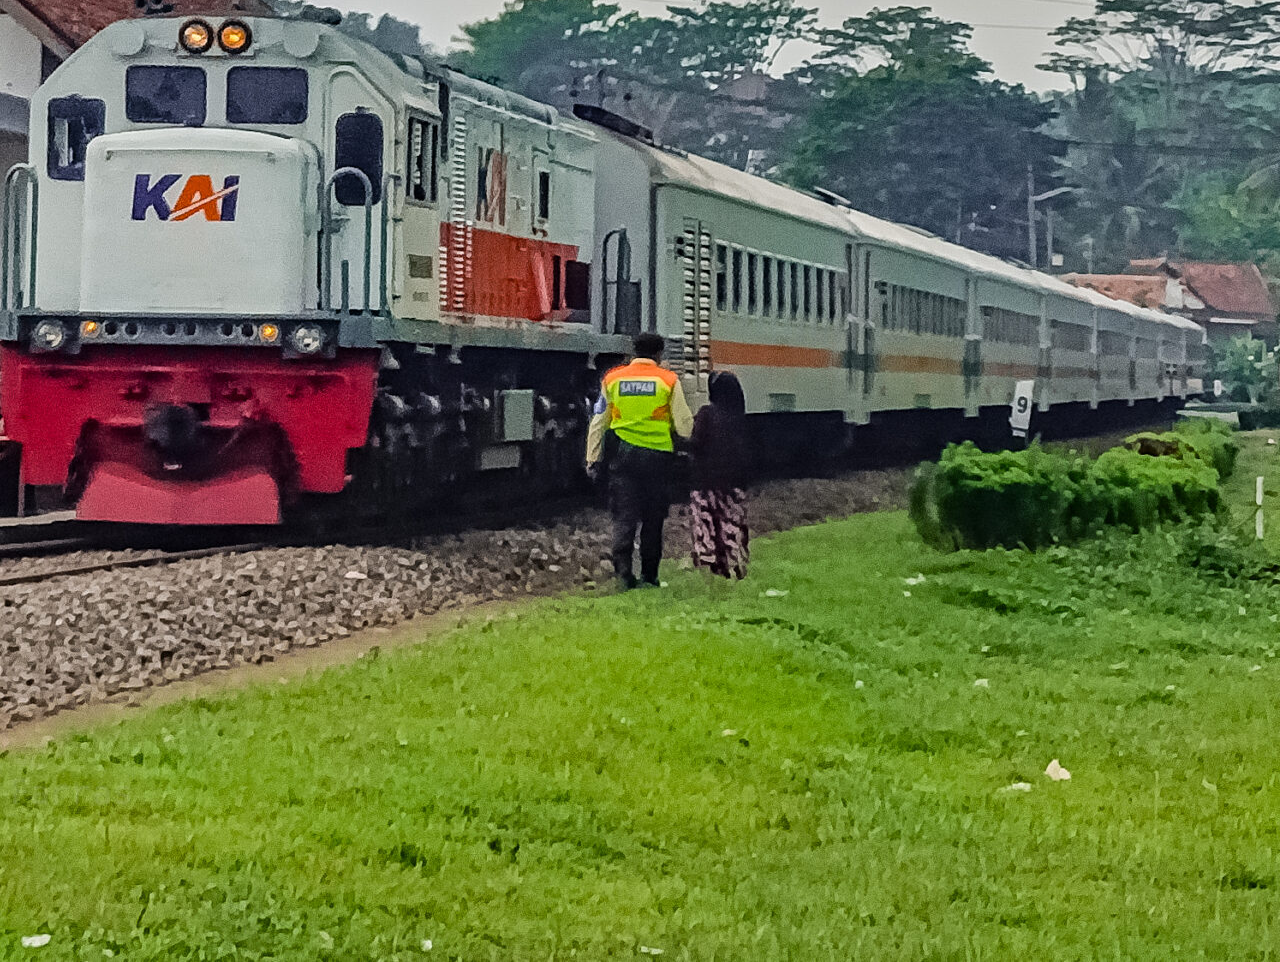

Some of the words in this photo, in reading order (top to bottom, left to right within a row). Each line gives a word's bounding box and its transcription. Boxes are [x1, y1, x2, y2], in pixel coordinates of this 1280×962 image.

[131, 174, 240, 221] KAI
[620, 381, 655, 393] SATPAM
[1017, 396, 1028, 413] 9
